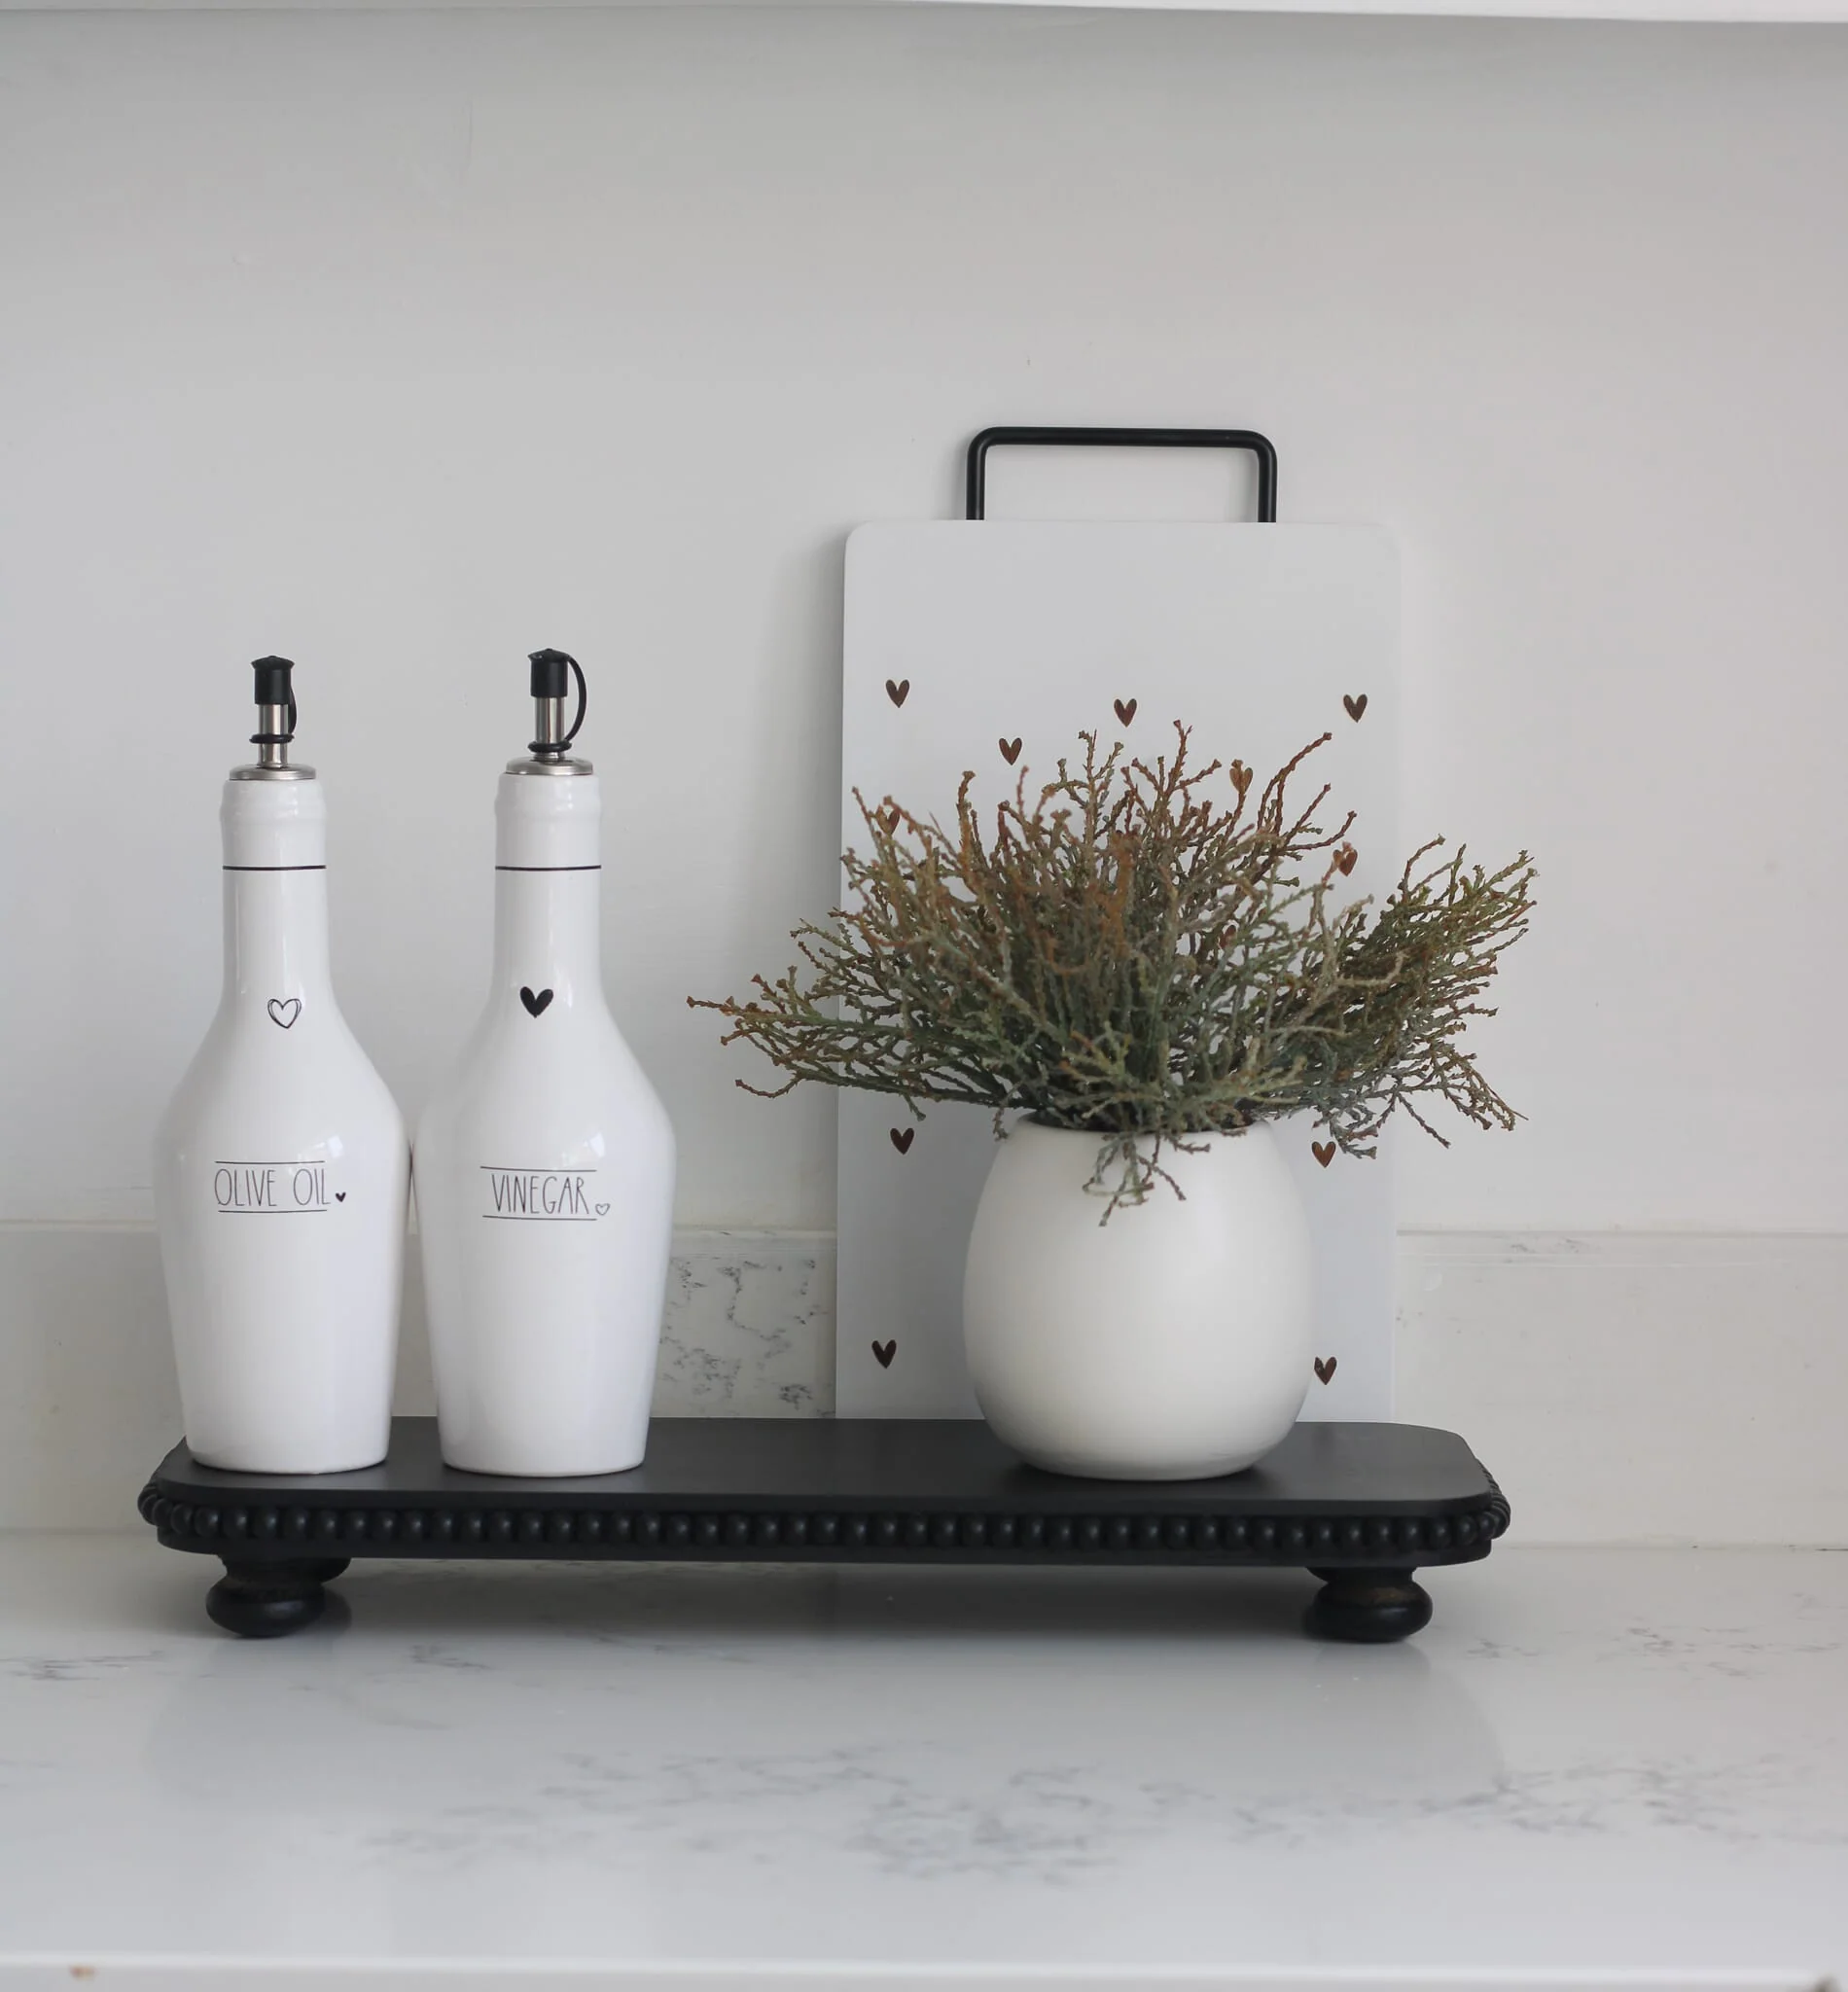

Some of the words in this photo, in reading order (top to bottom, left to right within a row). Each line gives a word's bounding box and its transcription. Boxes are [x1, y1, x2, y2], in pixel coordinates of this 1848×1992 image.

[214, 1168, 277, 1206] OLIVE
[293, 1168, 331, 1205] OIL
[491, 1174, 589, 1214] VINEGAR
